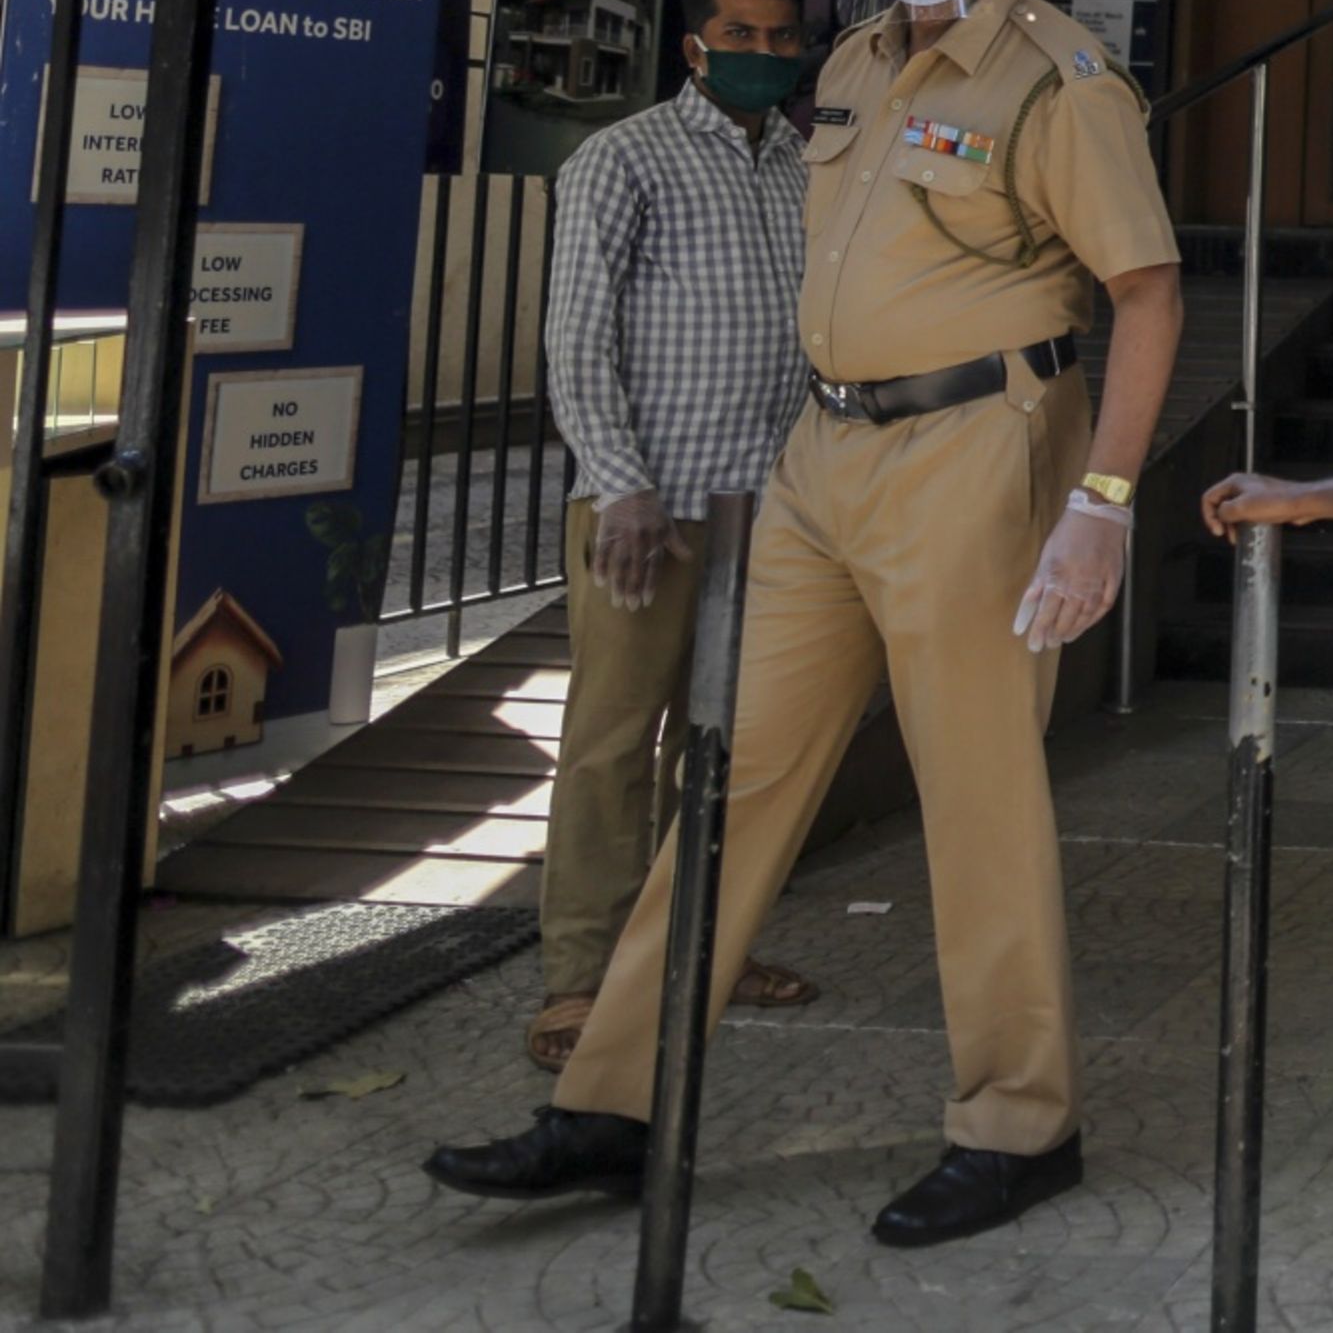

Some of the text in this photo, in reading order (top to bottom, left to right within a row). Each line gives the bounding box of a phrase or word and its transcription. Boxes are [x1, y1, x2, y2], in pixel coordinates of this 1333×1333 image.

[225, 8, 298, 36] LOAN
[303, 16, 329, 38] to
[333, 18, 372, 42] SBI
[83, 135, 140, 152] INTER
[102, 167, 139, 184] RAT
[202, 256, 242, 272] LOW
[200, 318, 231, 334] FEE
[272, 401, 298, 417] NO
[250, 431, 315, 449] HIDDEN
[240, 459, 318, 481] CHARGES
